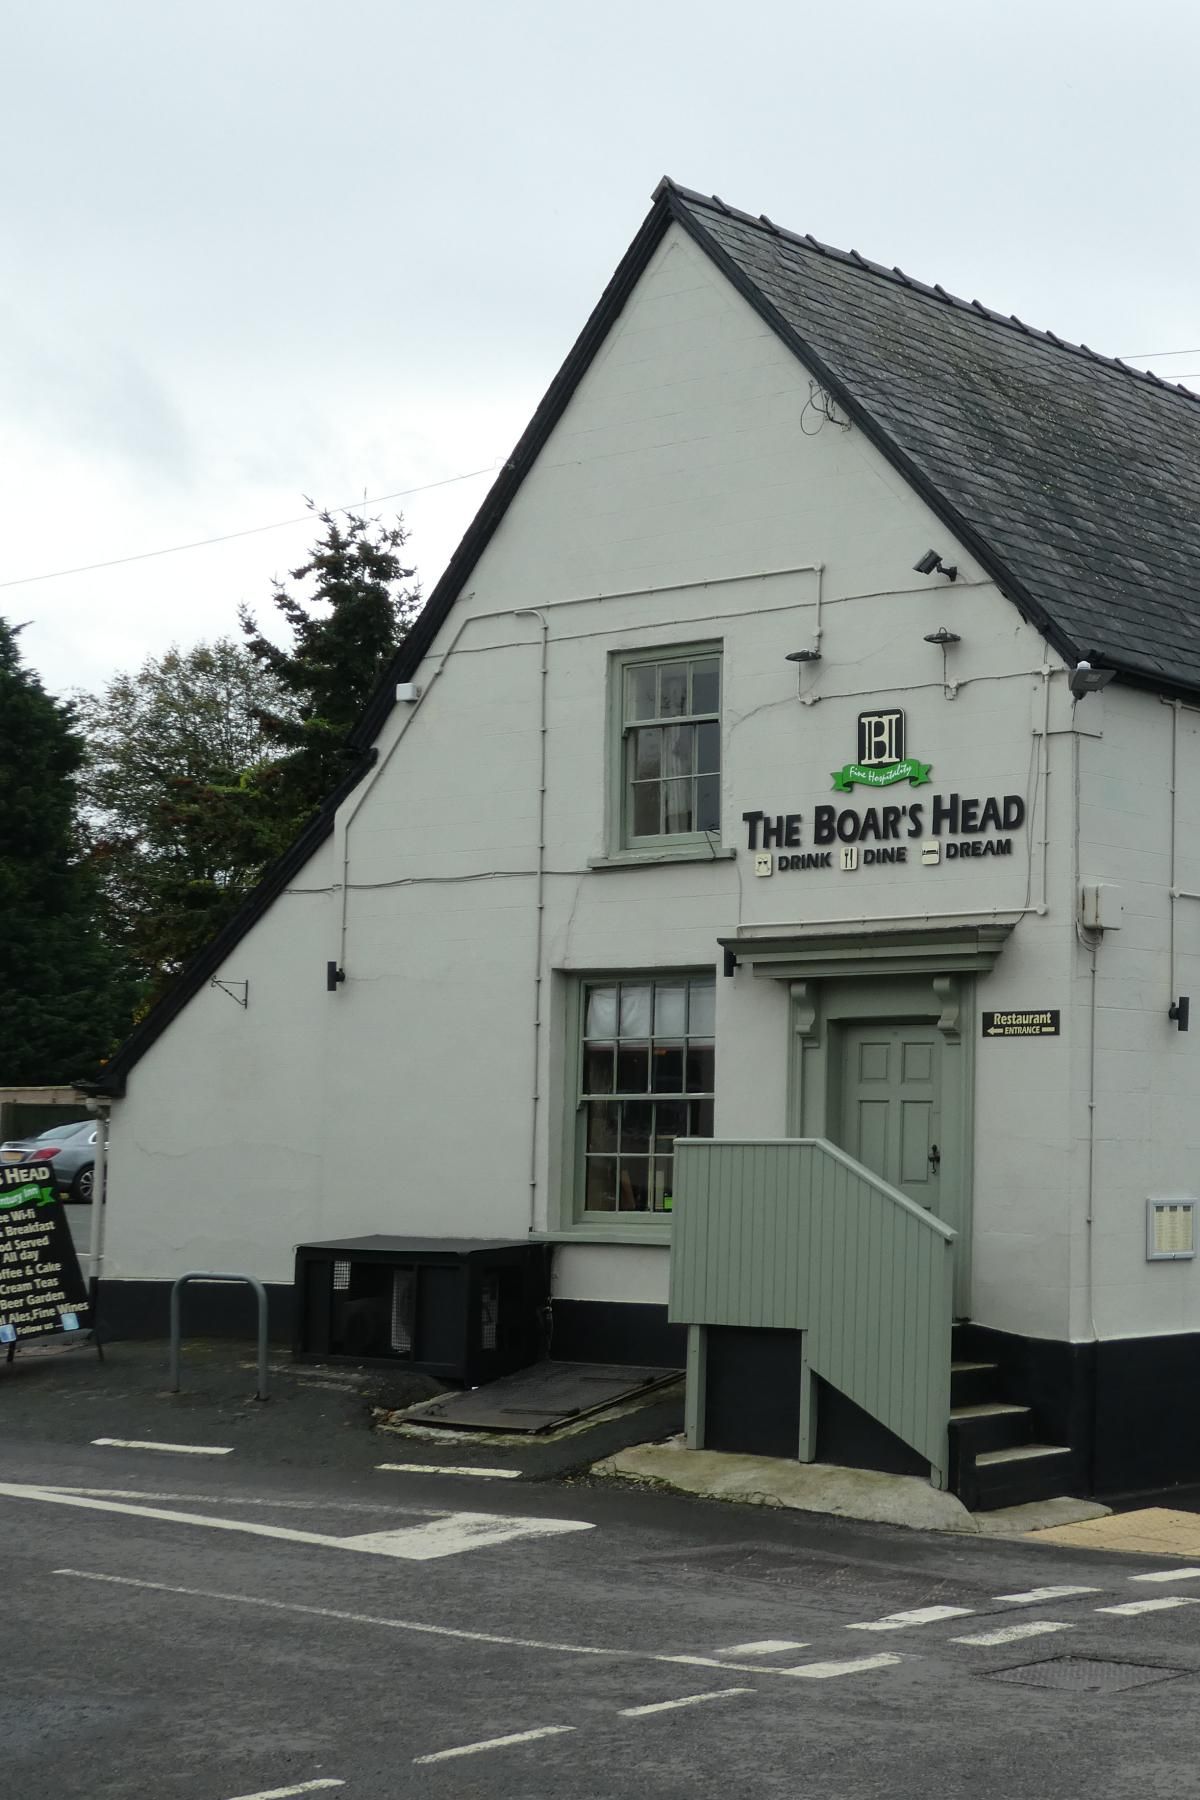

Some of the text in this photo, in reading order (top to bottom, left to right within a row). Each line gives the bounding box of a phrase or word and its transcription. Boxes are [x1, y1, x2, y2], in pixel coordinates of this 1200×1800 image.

[849, 763, 912, 785] Fine Hospitality
[742, 793, 1026, 850] THE BOAR'S HEAD
[777, 838, 1012, 872] DRINK DINE DREAM
[993, 1012, 1052, 1025] Restaurant
[1004, 1025, 1040, 1035] ENTRANCE
[4, 1166, 50, 1184] HEAD
[10, 1208, 36, 1221] Wi-fi
[5, 1221, 56, 1237] Breakfast
[14, 1235, 50, 1250] Served
[3, 1250, 39, 1263] All day
[25, 1265, 34, 1276] &
[35, 1262, 62, 1274] Cake
[0, 1278, 59, 1295] Cream Teas
[0, 1291, 66, 1310] Beer Garden
[57, 1302, 90, 1315] Wines
[16, 1322, 54, 1336] Follow us
